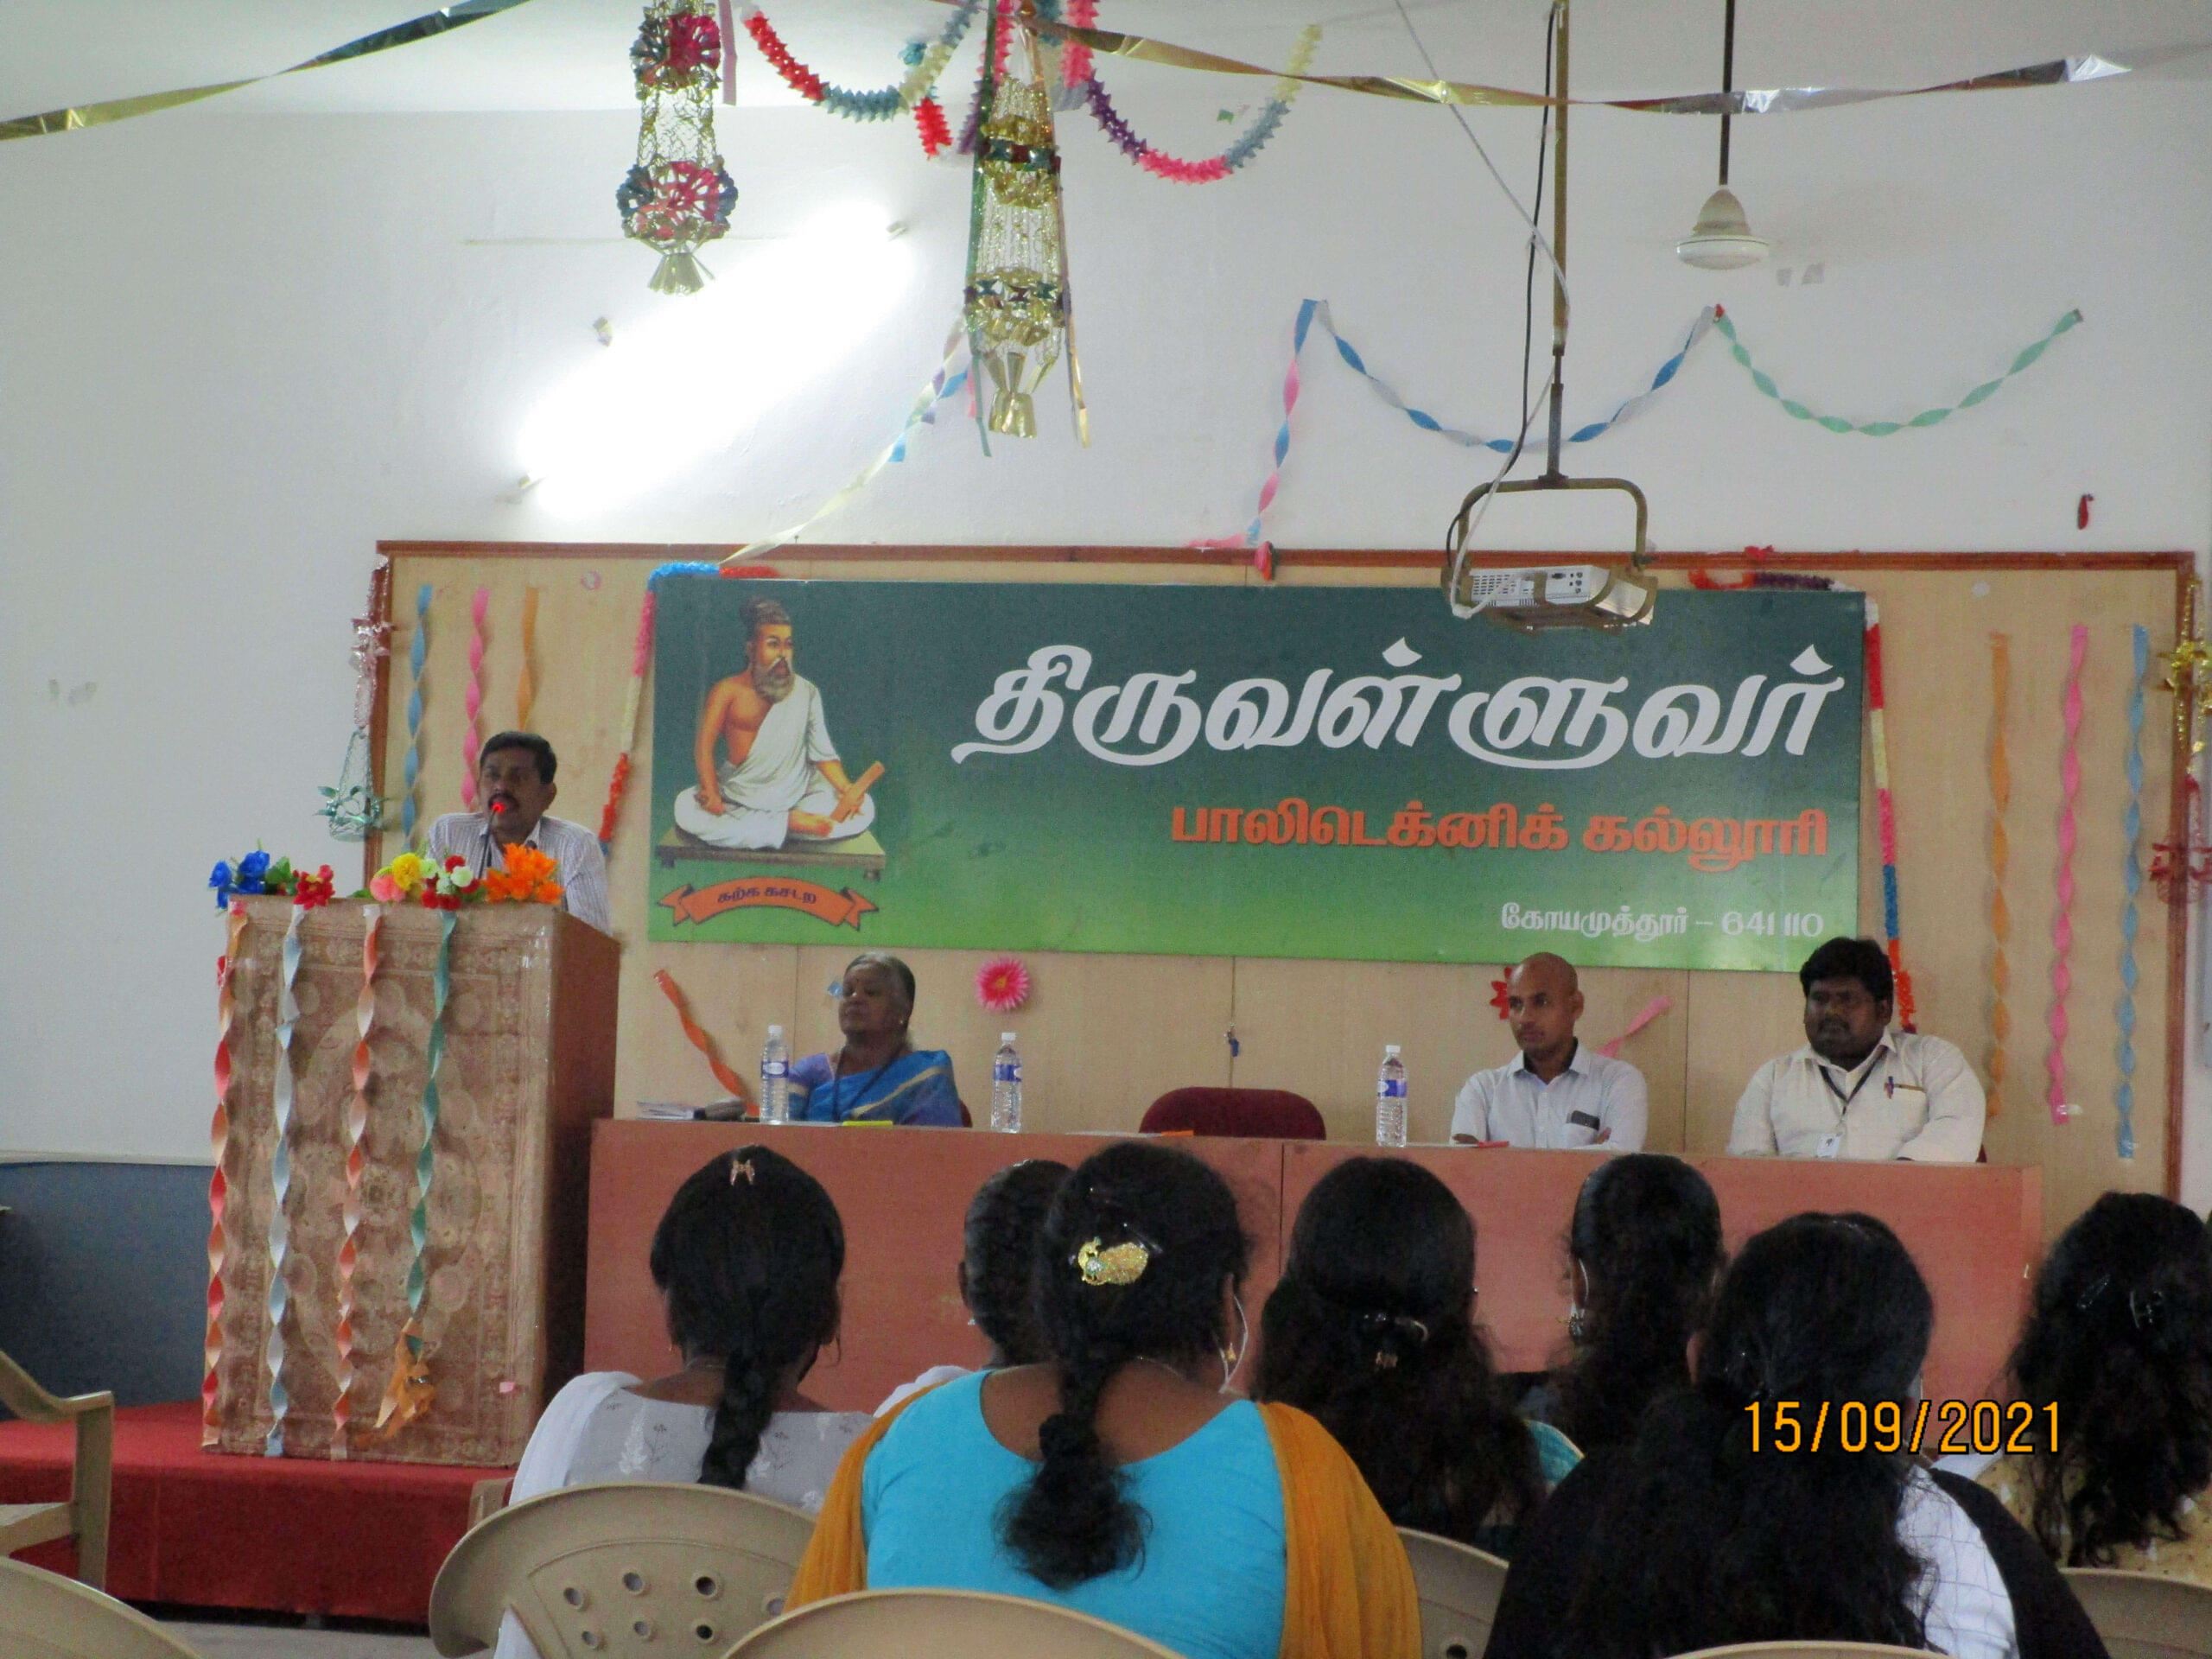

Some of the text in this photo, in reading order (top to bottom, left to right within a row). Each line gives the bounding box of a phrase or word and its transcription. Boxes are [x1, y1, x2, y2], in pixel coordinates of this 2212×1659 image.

[951, 637, 1844, 769] திருவள்ளுவர்
[1172, 798, 1827, 873] பாலிடெக்னிக் கல்லூரி
[1502, 902, 1689, 942] கோயமுத்தூர்
